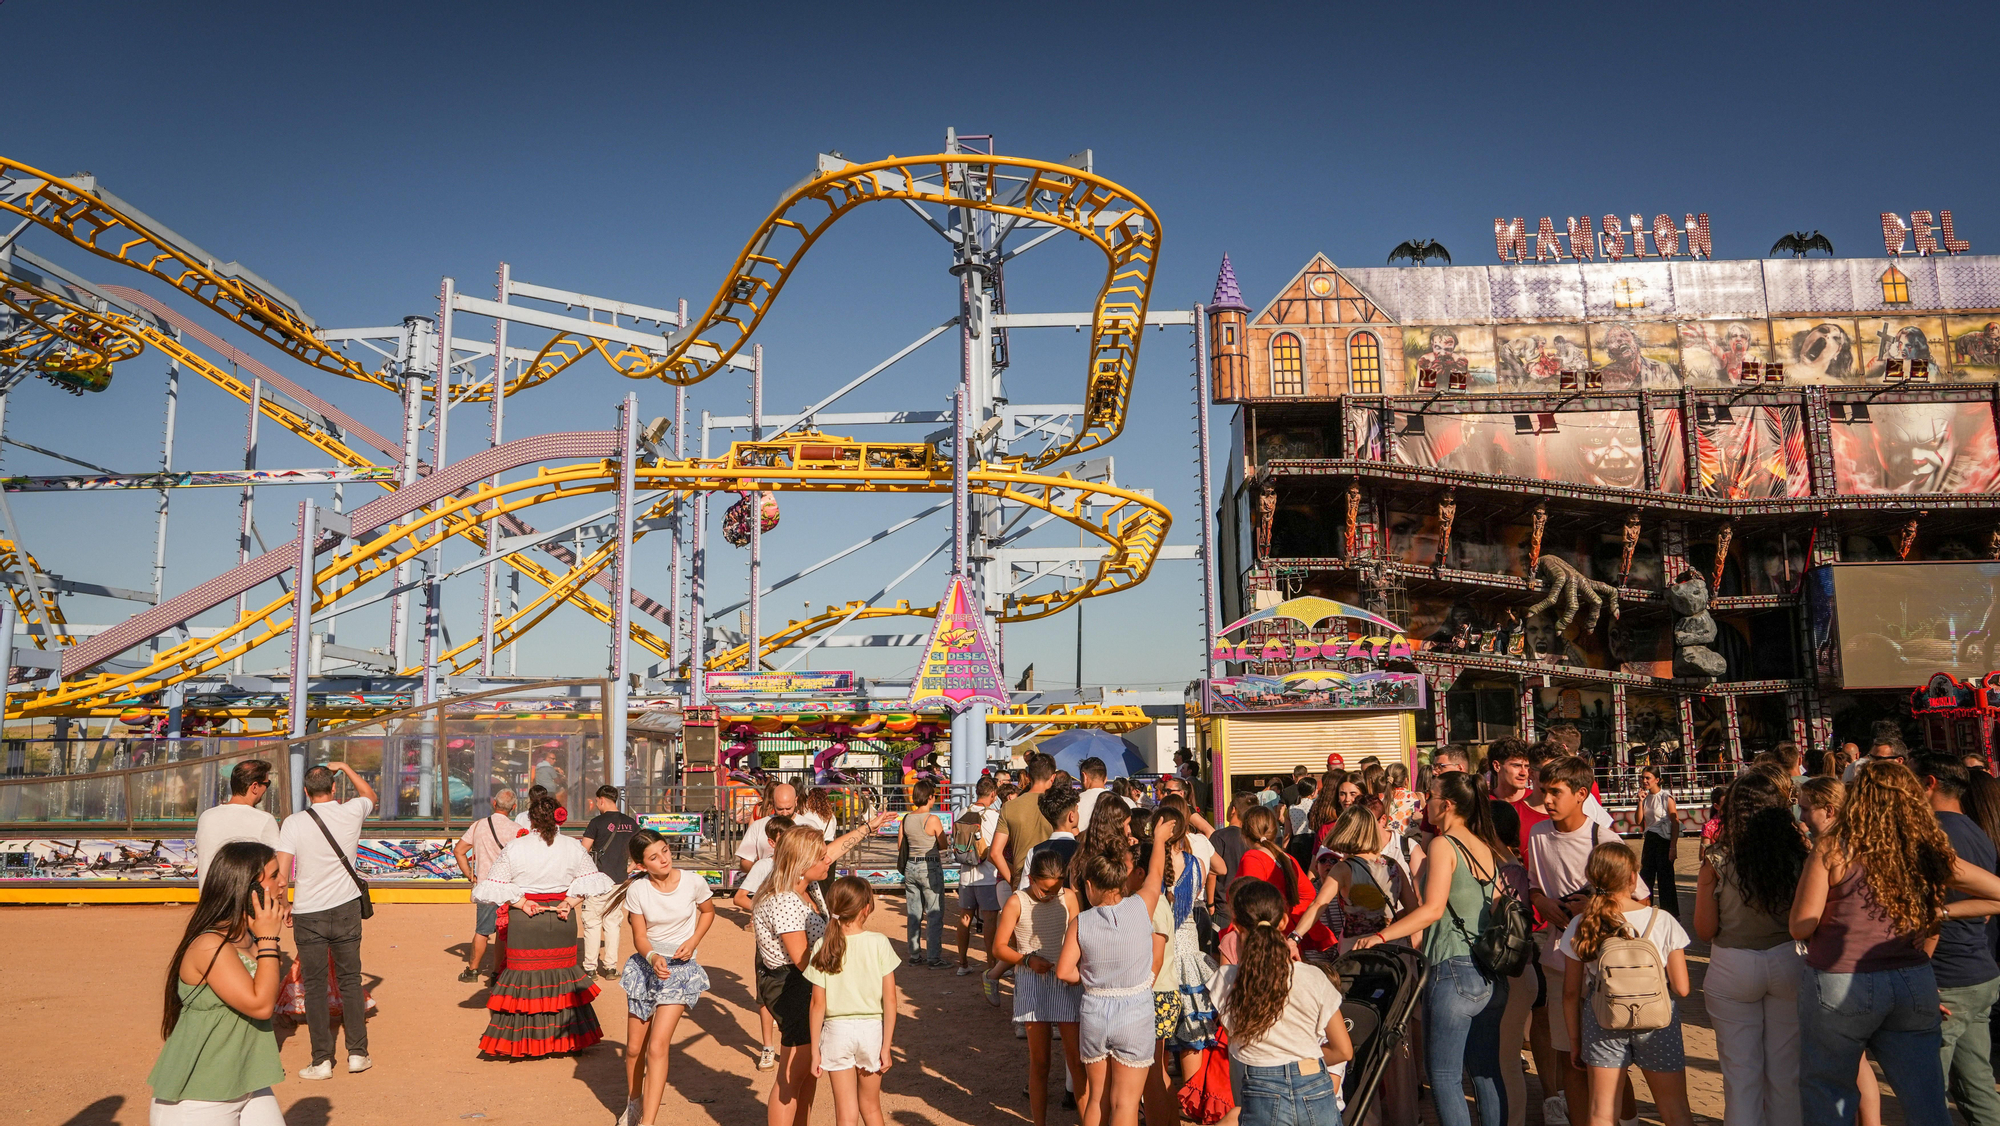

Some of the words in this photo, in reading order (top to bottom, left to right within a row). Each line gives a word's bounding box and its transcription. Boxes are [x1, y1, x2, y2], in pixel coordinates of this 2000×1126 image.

[1494, 213, 1711, 263] MANSION
[1880, 210, 1970, 257] DEL
[945, 614, 973, 622] PULSE
[931, 652, 944, 660] SI
[947, 652, 987, 660] DESEA
[929, 664, 990, 674] EFECTOS
[922, 676, 996, 689] REFRESCANTES
